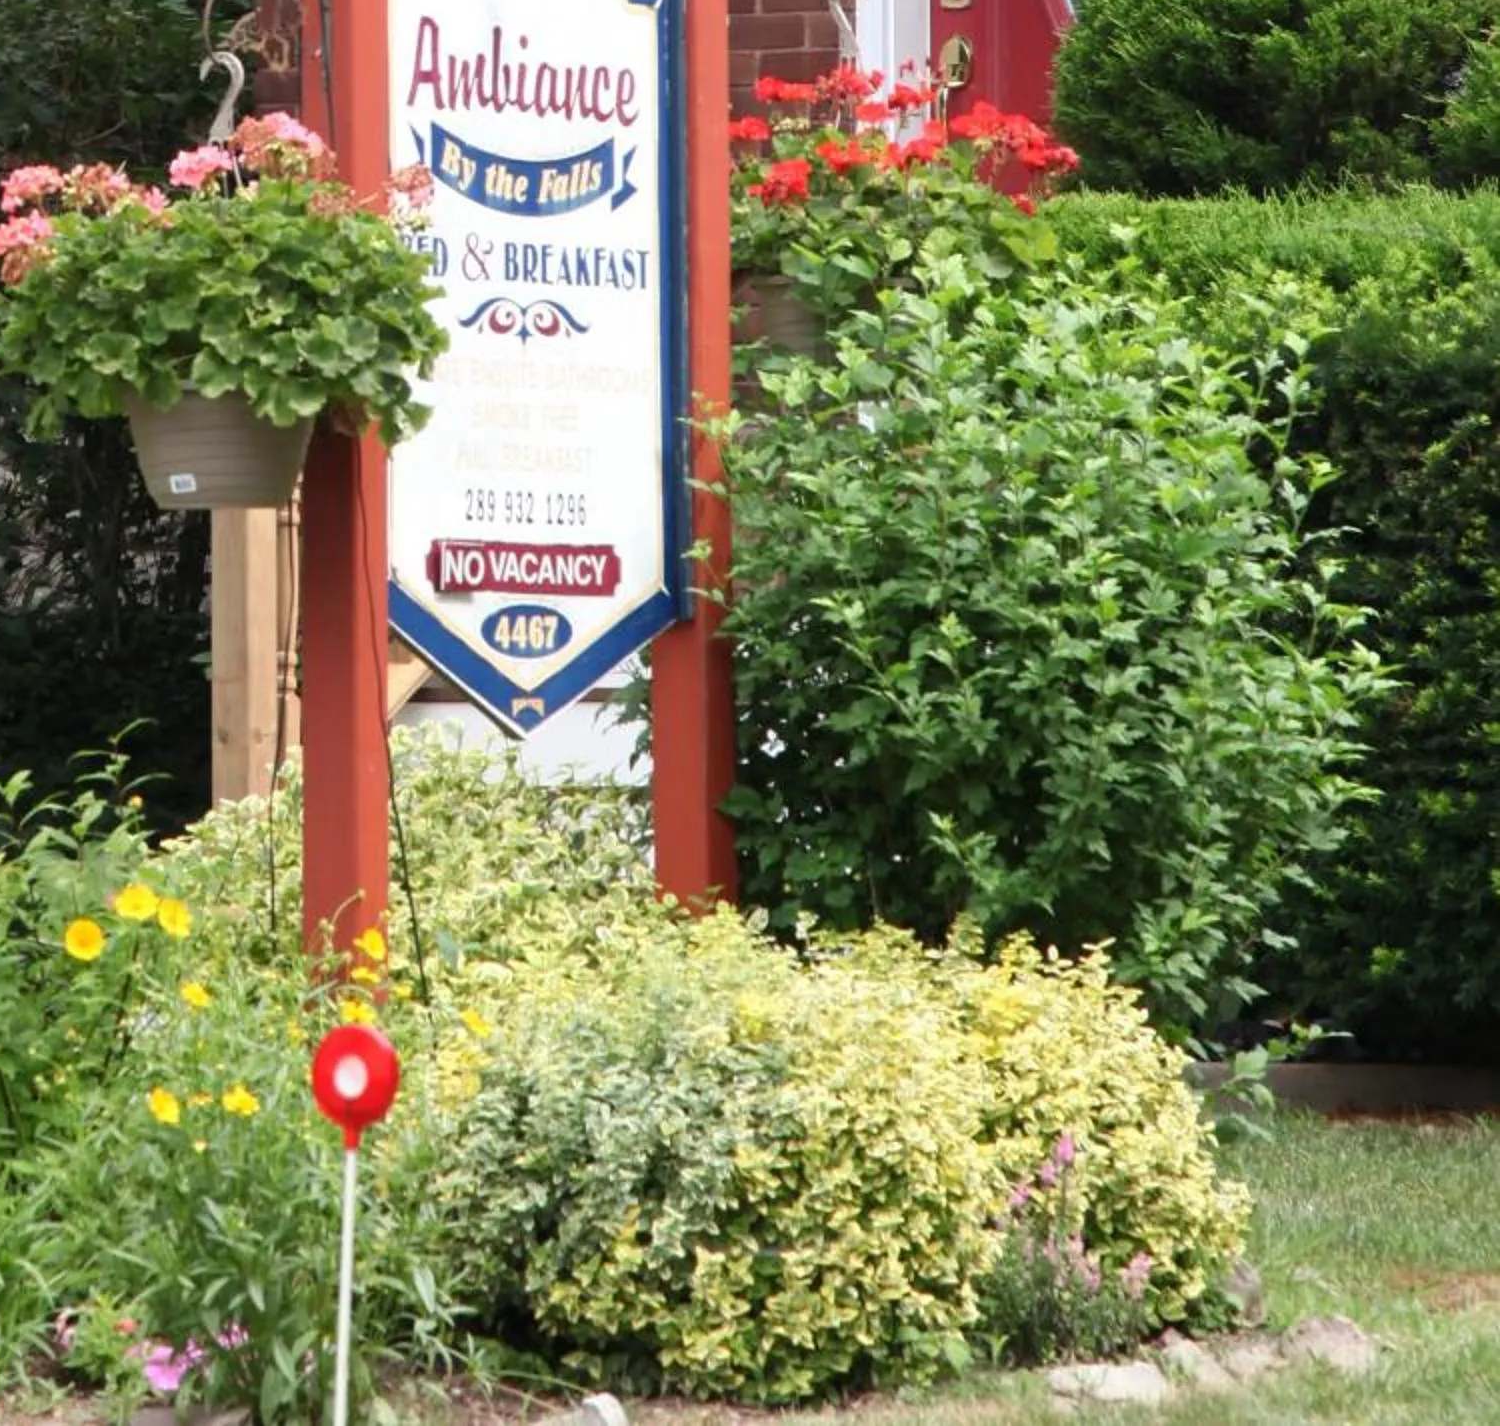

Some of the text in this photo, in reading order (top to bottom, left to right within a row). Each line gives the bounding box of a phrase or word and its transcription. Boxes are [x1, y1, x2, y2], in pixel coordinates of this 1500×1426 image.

[407, 15, 639, 127] Ambiance
[440, 138, 603, 204] By the Falls
[462, 232, 494, 282] &
[504, 241, 650, 290] BREAKFAST
[465, 489, 587, 526] 289 932 1296
[444, 550, 607, 586] NO VACANCY
[494, 614, 558, 650] 4467
